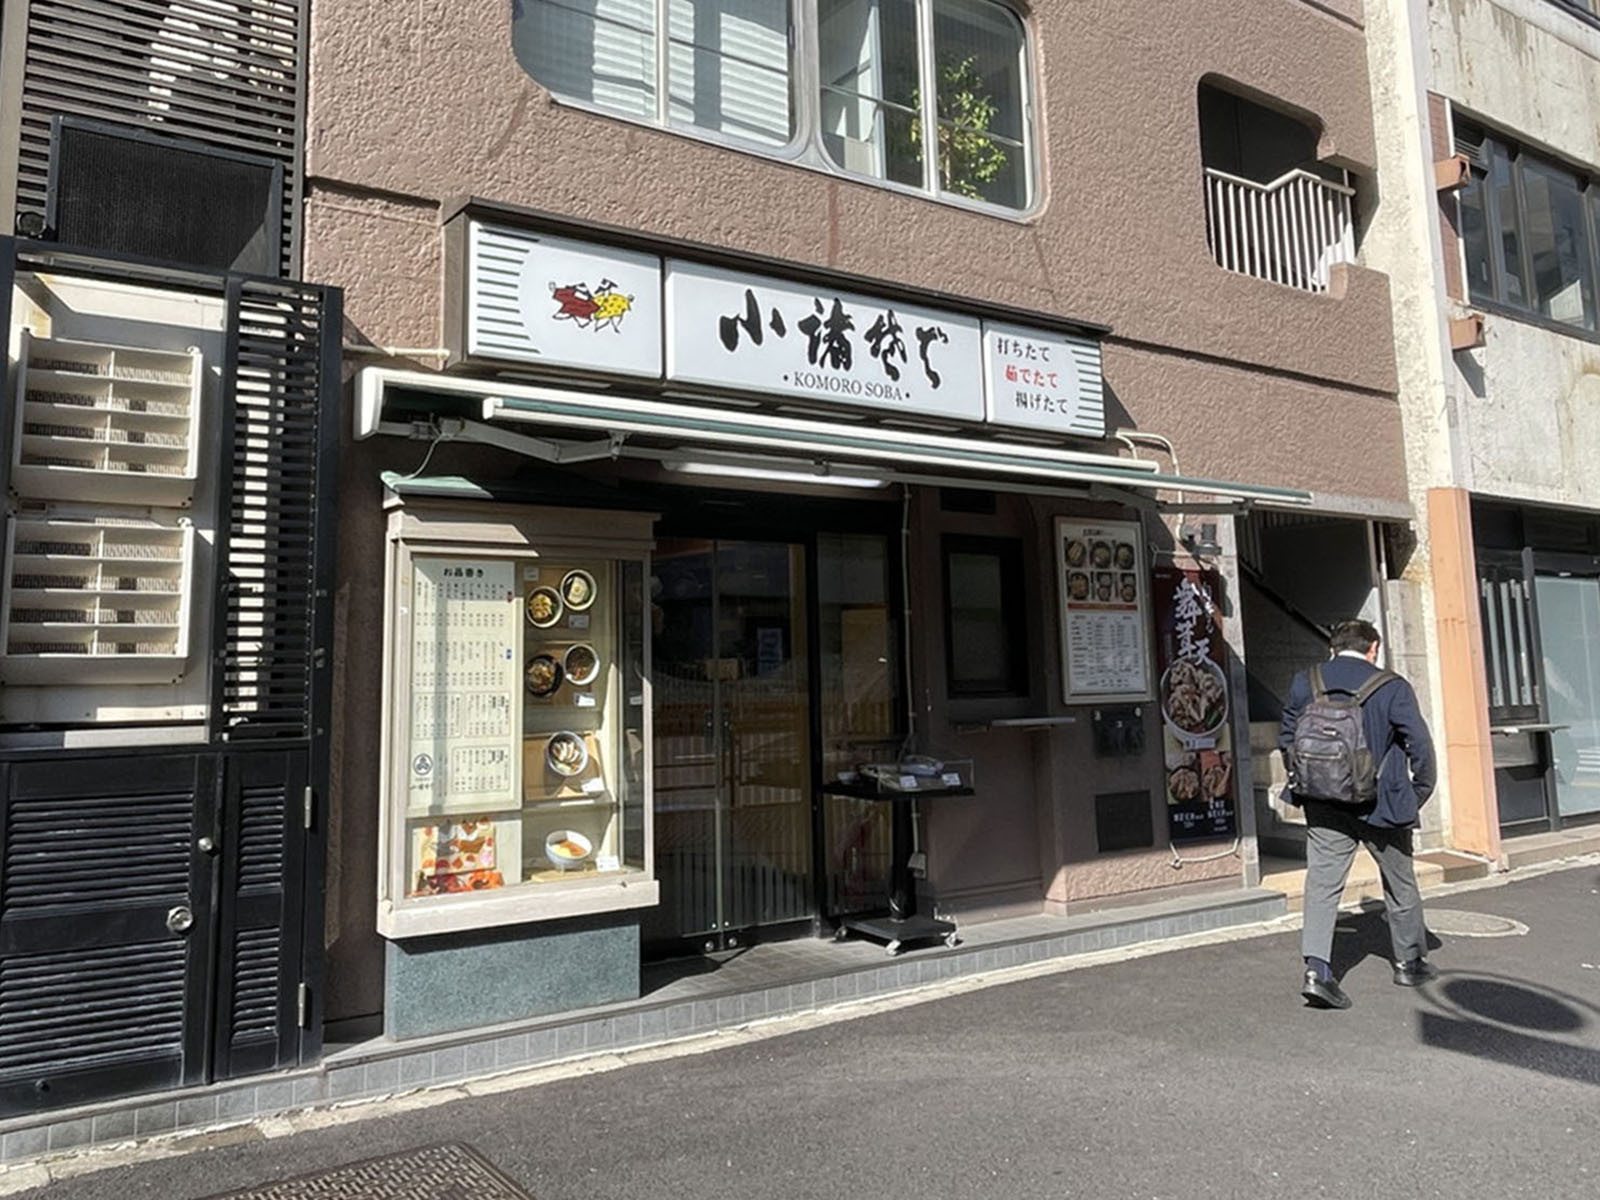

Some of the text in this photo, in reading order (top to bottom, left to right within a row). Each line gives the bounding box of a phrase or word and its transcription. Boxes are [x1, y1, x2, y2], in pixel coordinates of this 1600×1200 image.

[997, 337, 1050, 362] 打ちたて
[793, 371, 903, 401] KOMORO SOBA
[1005, 364, 1058, 389] 茹でたて
[1015, 391, 1068, 414] 揚げたて
